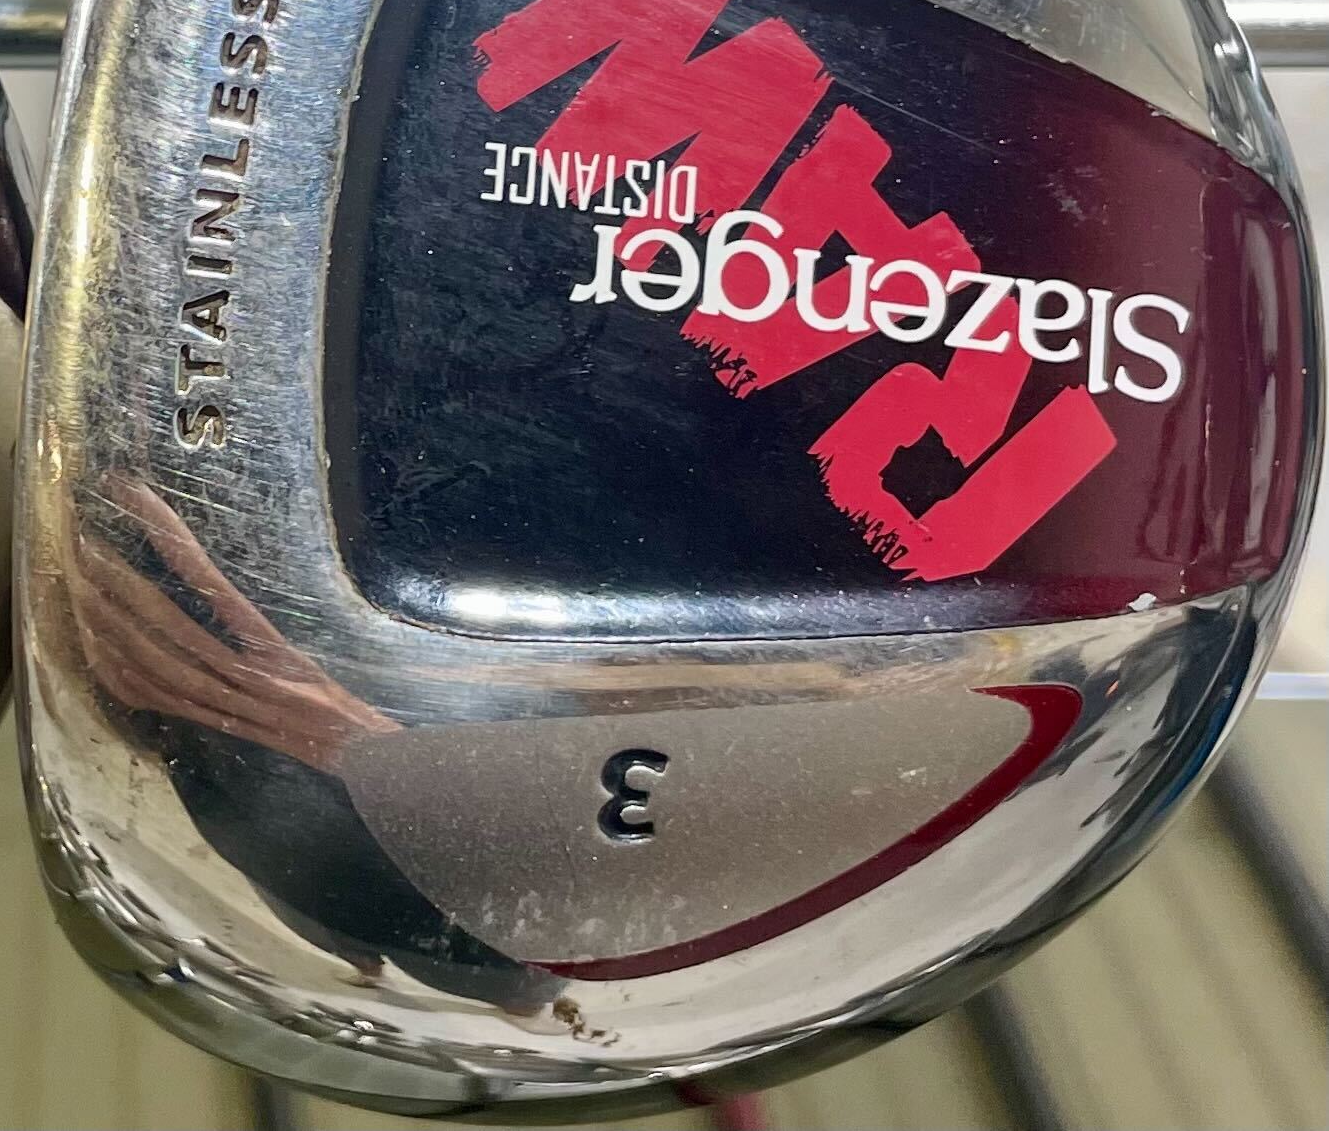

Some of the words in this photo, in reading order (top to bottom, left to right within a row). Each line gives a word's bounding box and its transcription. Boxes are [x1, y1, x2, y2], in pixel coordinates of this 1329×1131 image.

[480, 141, 698, 225] DISTANCE
[570, 209, 1190, 403] Slazenger
[597, 748, 670, 845] 3
